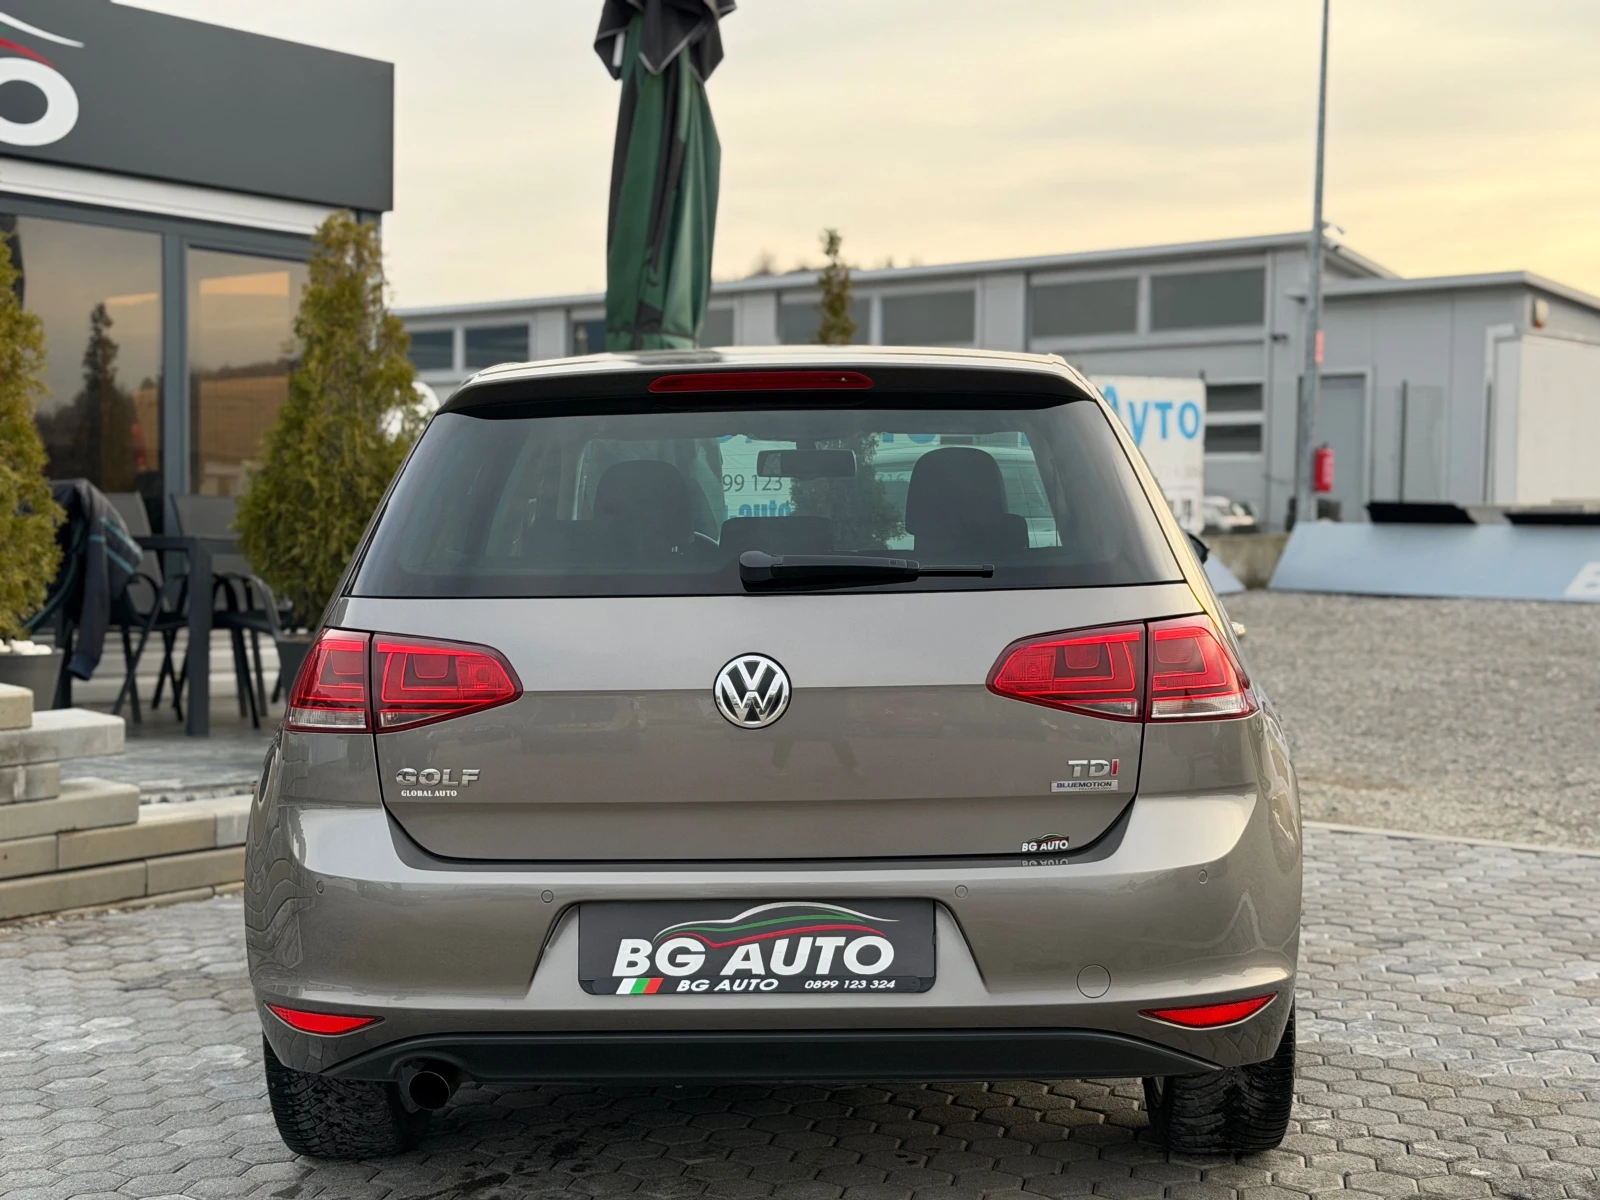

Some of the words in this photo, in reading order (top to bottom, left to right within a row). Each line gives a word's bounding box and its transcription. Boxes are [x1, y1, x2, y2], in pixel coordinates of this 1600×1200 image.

[396, 768, 480, 786] GOLF
[1068, 759, 1119, 777] TDI
[1022, 842, 1037, 852] BG
[1040, 840, 1068, 851] AUTO
[612, 937, 706, 977] BG
[719, 935, 894, 976] AUTO
[676, 979, 710, 992] BG
[713, 978, 779, 991] AUTO
[804, 980, 839, 989] 0899
[843, 980, 867, 989] 123
[870, 980, 896, 989] 324
